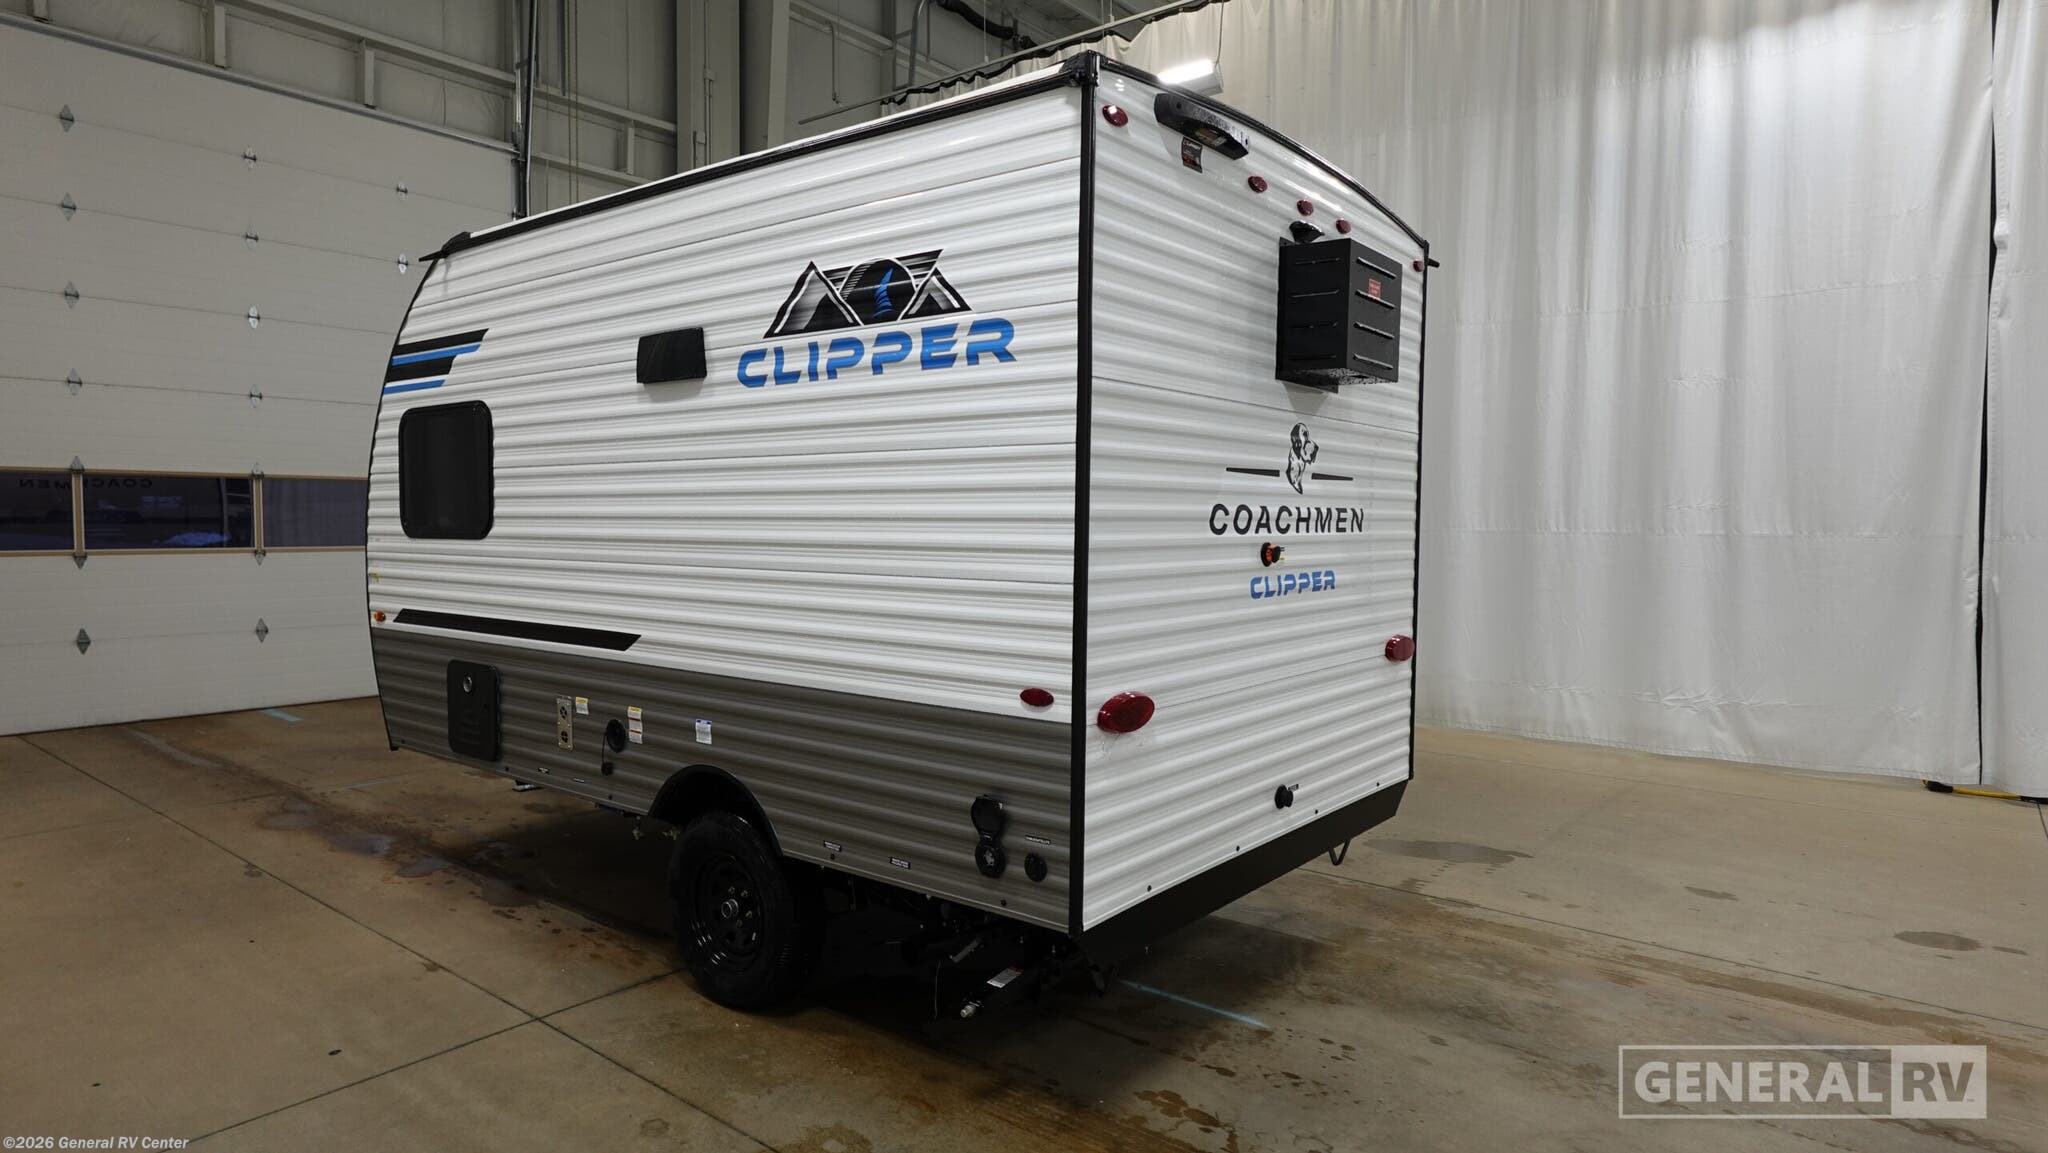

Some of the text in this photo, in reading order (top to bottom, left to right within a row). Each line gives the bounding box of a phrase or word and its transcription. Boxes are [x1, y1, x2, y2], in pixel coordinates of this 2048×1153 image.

[737, 317, 1017, 388] CLIPPER
[1209, 503, 1364, 535] COACHMEN
[1250, 570, 1336, 599] CLIPPER
